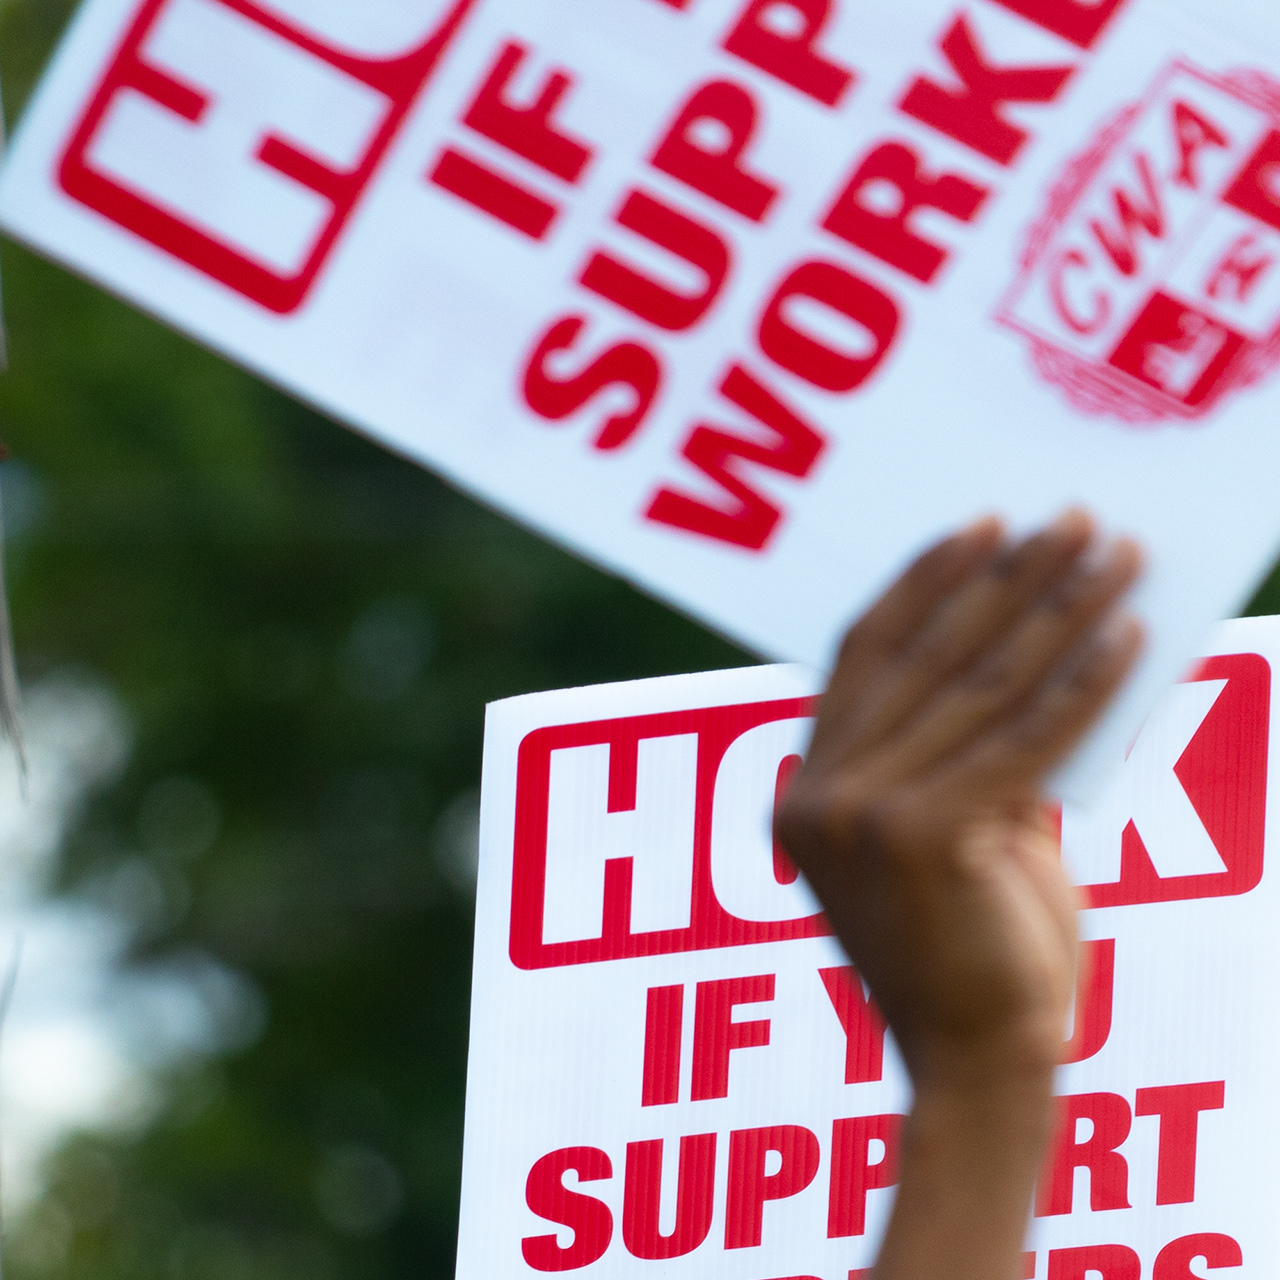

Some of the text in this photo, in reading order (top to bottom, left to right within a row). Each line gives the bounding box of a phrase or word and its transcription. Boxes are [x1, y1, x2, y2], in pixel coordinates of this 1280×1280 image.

[426, 39, 594, 243] IF
[1048, 97, 1232, 338] CWA
[640, 937, 1117, 1109] IF YU
[520, 1080, 1227, 1274] SUPPRT
